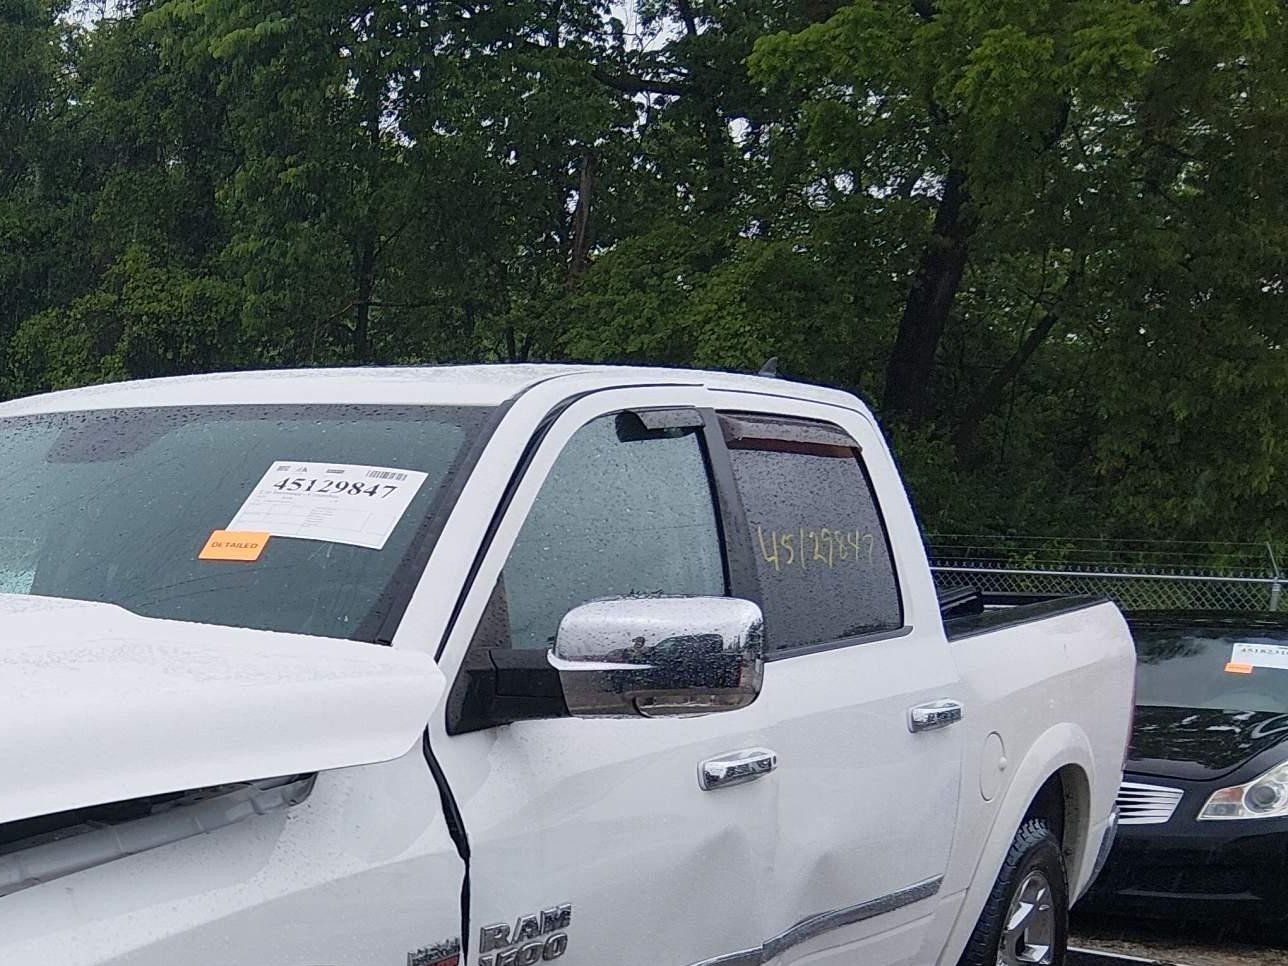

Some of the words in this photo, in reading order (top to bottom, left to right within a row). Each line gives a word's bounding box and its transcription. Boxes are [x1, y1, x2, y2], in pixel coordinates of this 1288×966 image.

[274, 478, 398, 498] 45129847
[211, 541, 258, 549] DETAILED
[759, 527, 873, 571] 45129847
[480, 903, 572, 953] RAM
